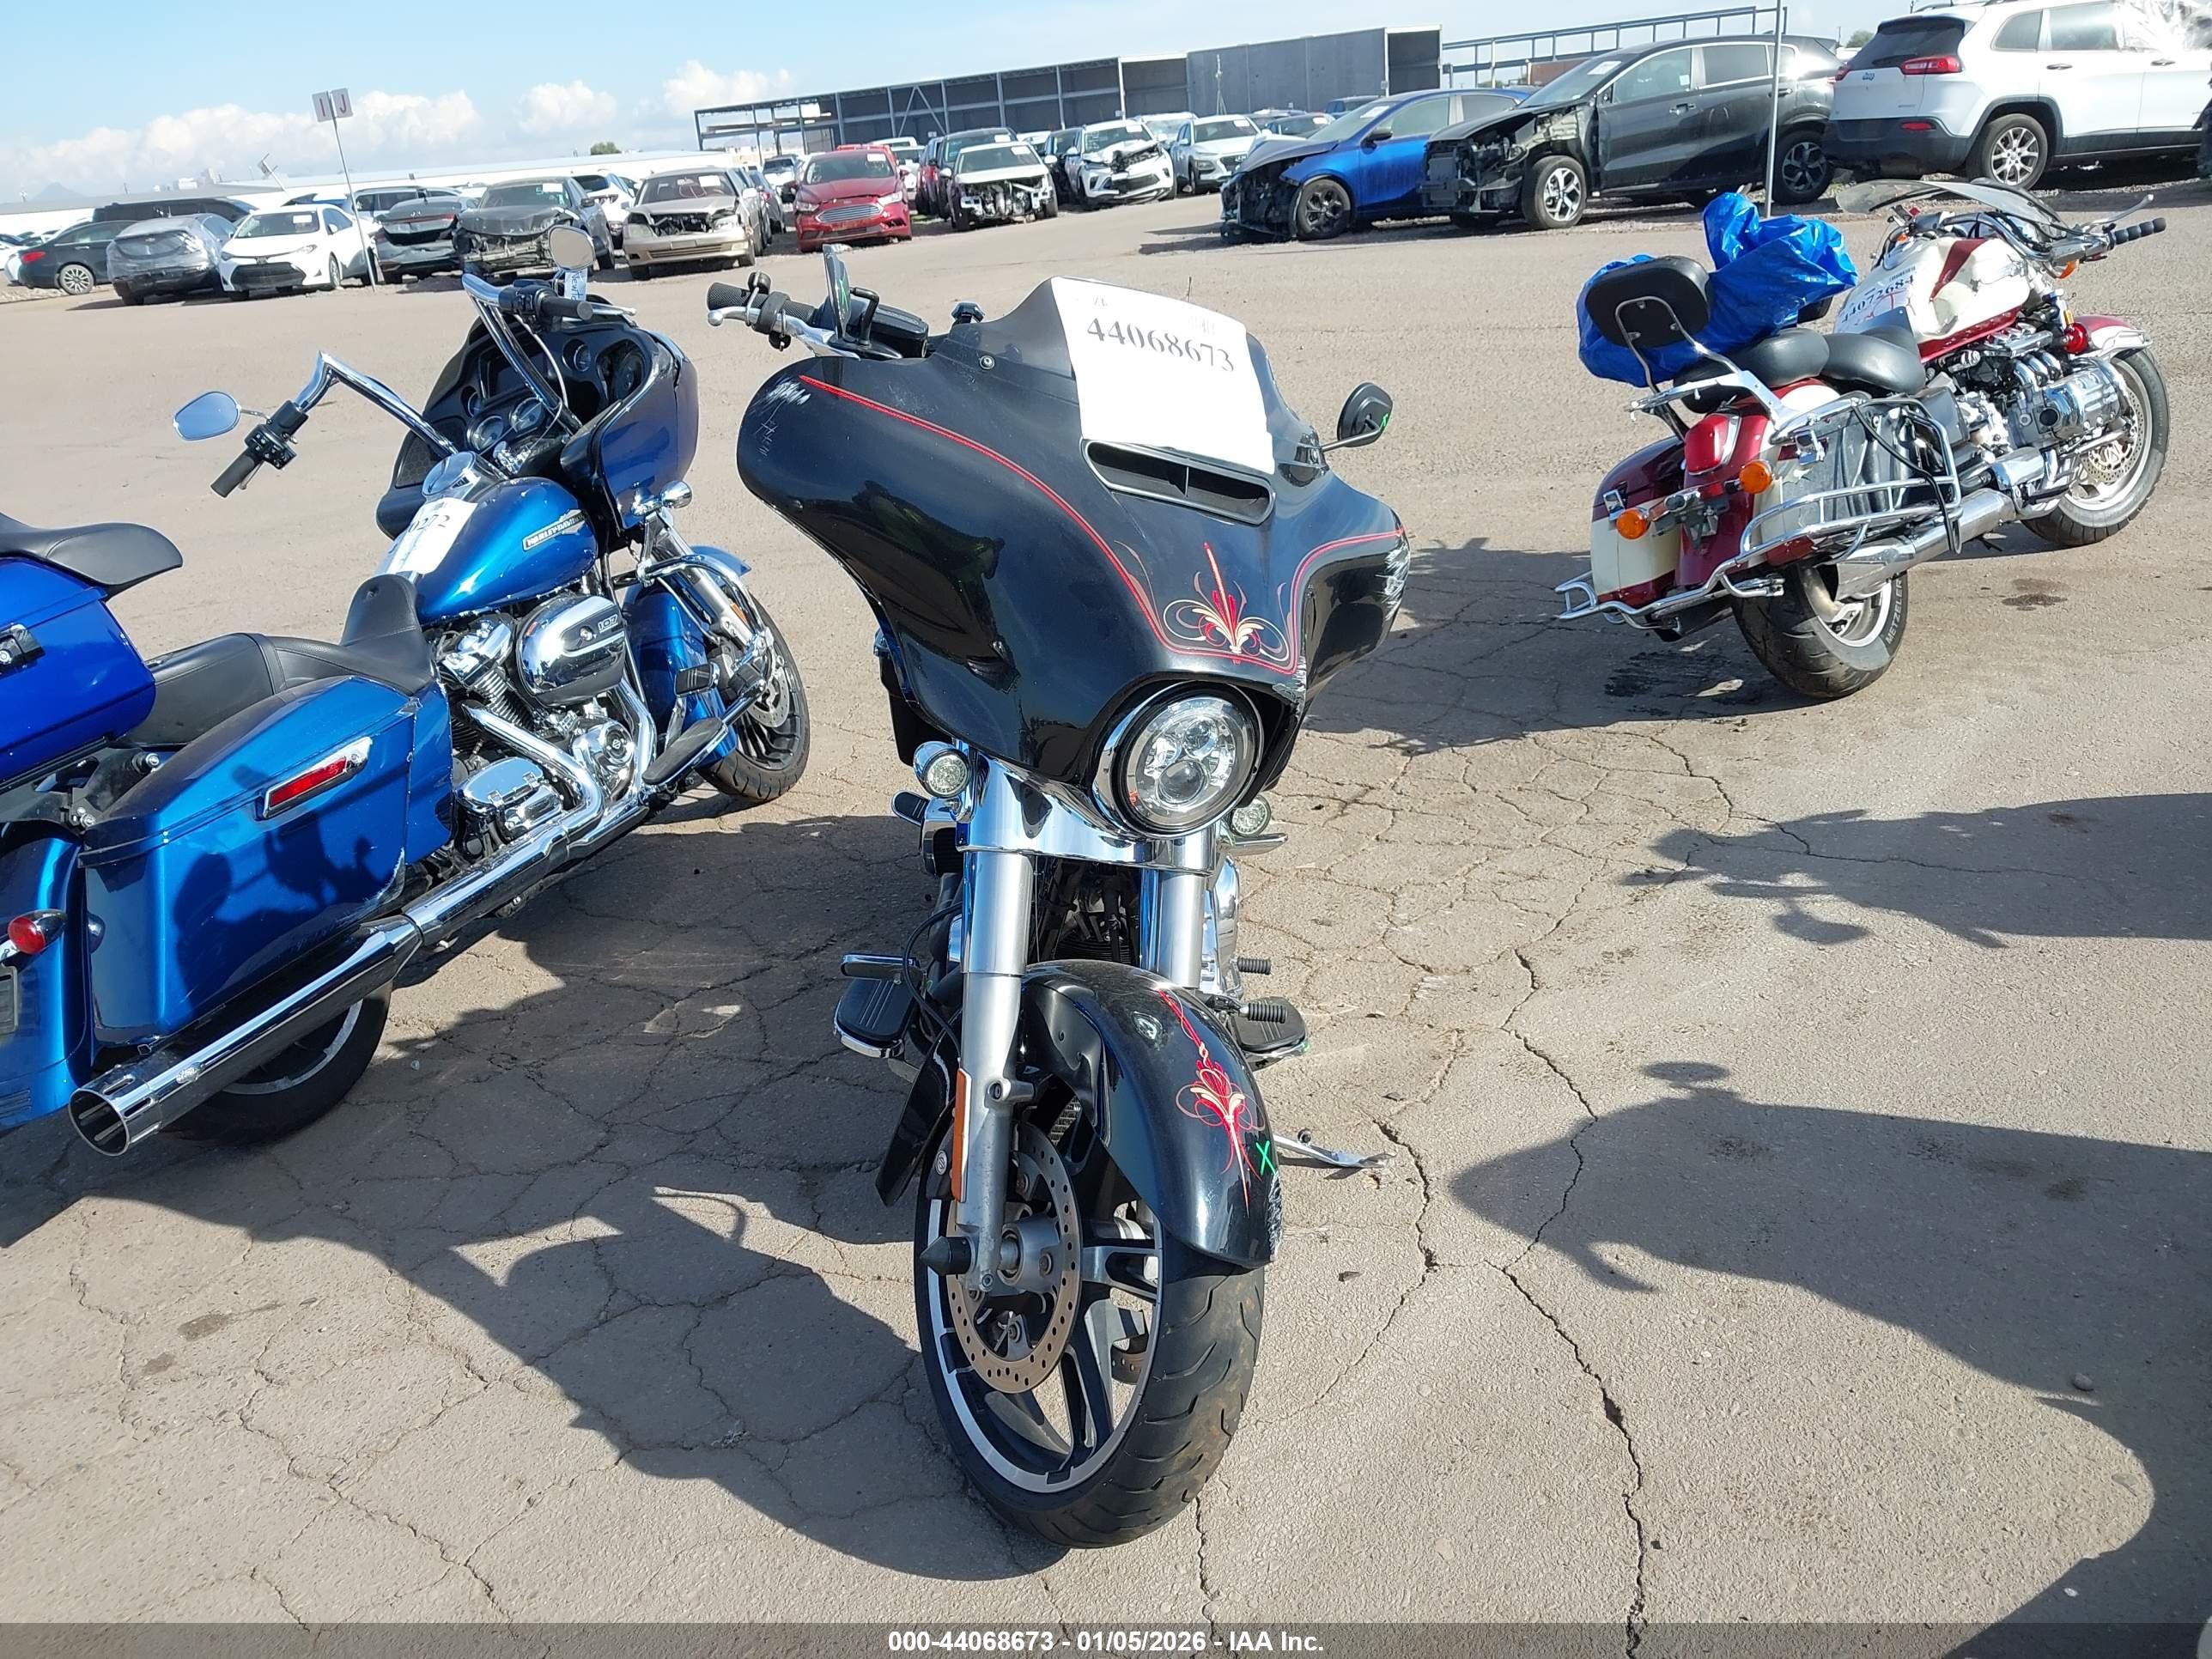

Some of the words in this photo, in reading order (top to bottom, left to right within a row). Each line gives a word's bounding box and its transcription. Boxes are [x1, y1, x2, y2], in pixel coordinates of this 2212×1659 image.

[339, 94, 347, 113] J
[1086, 318, 1234, 371] 44068673
[597, 613, 618, 634] 107
[1885, 579, 1904, 645] METZELER
